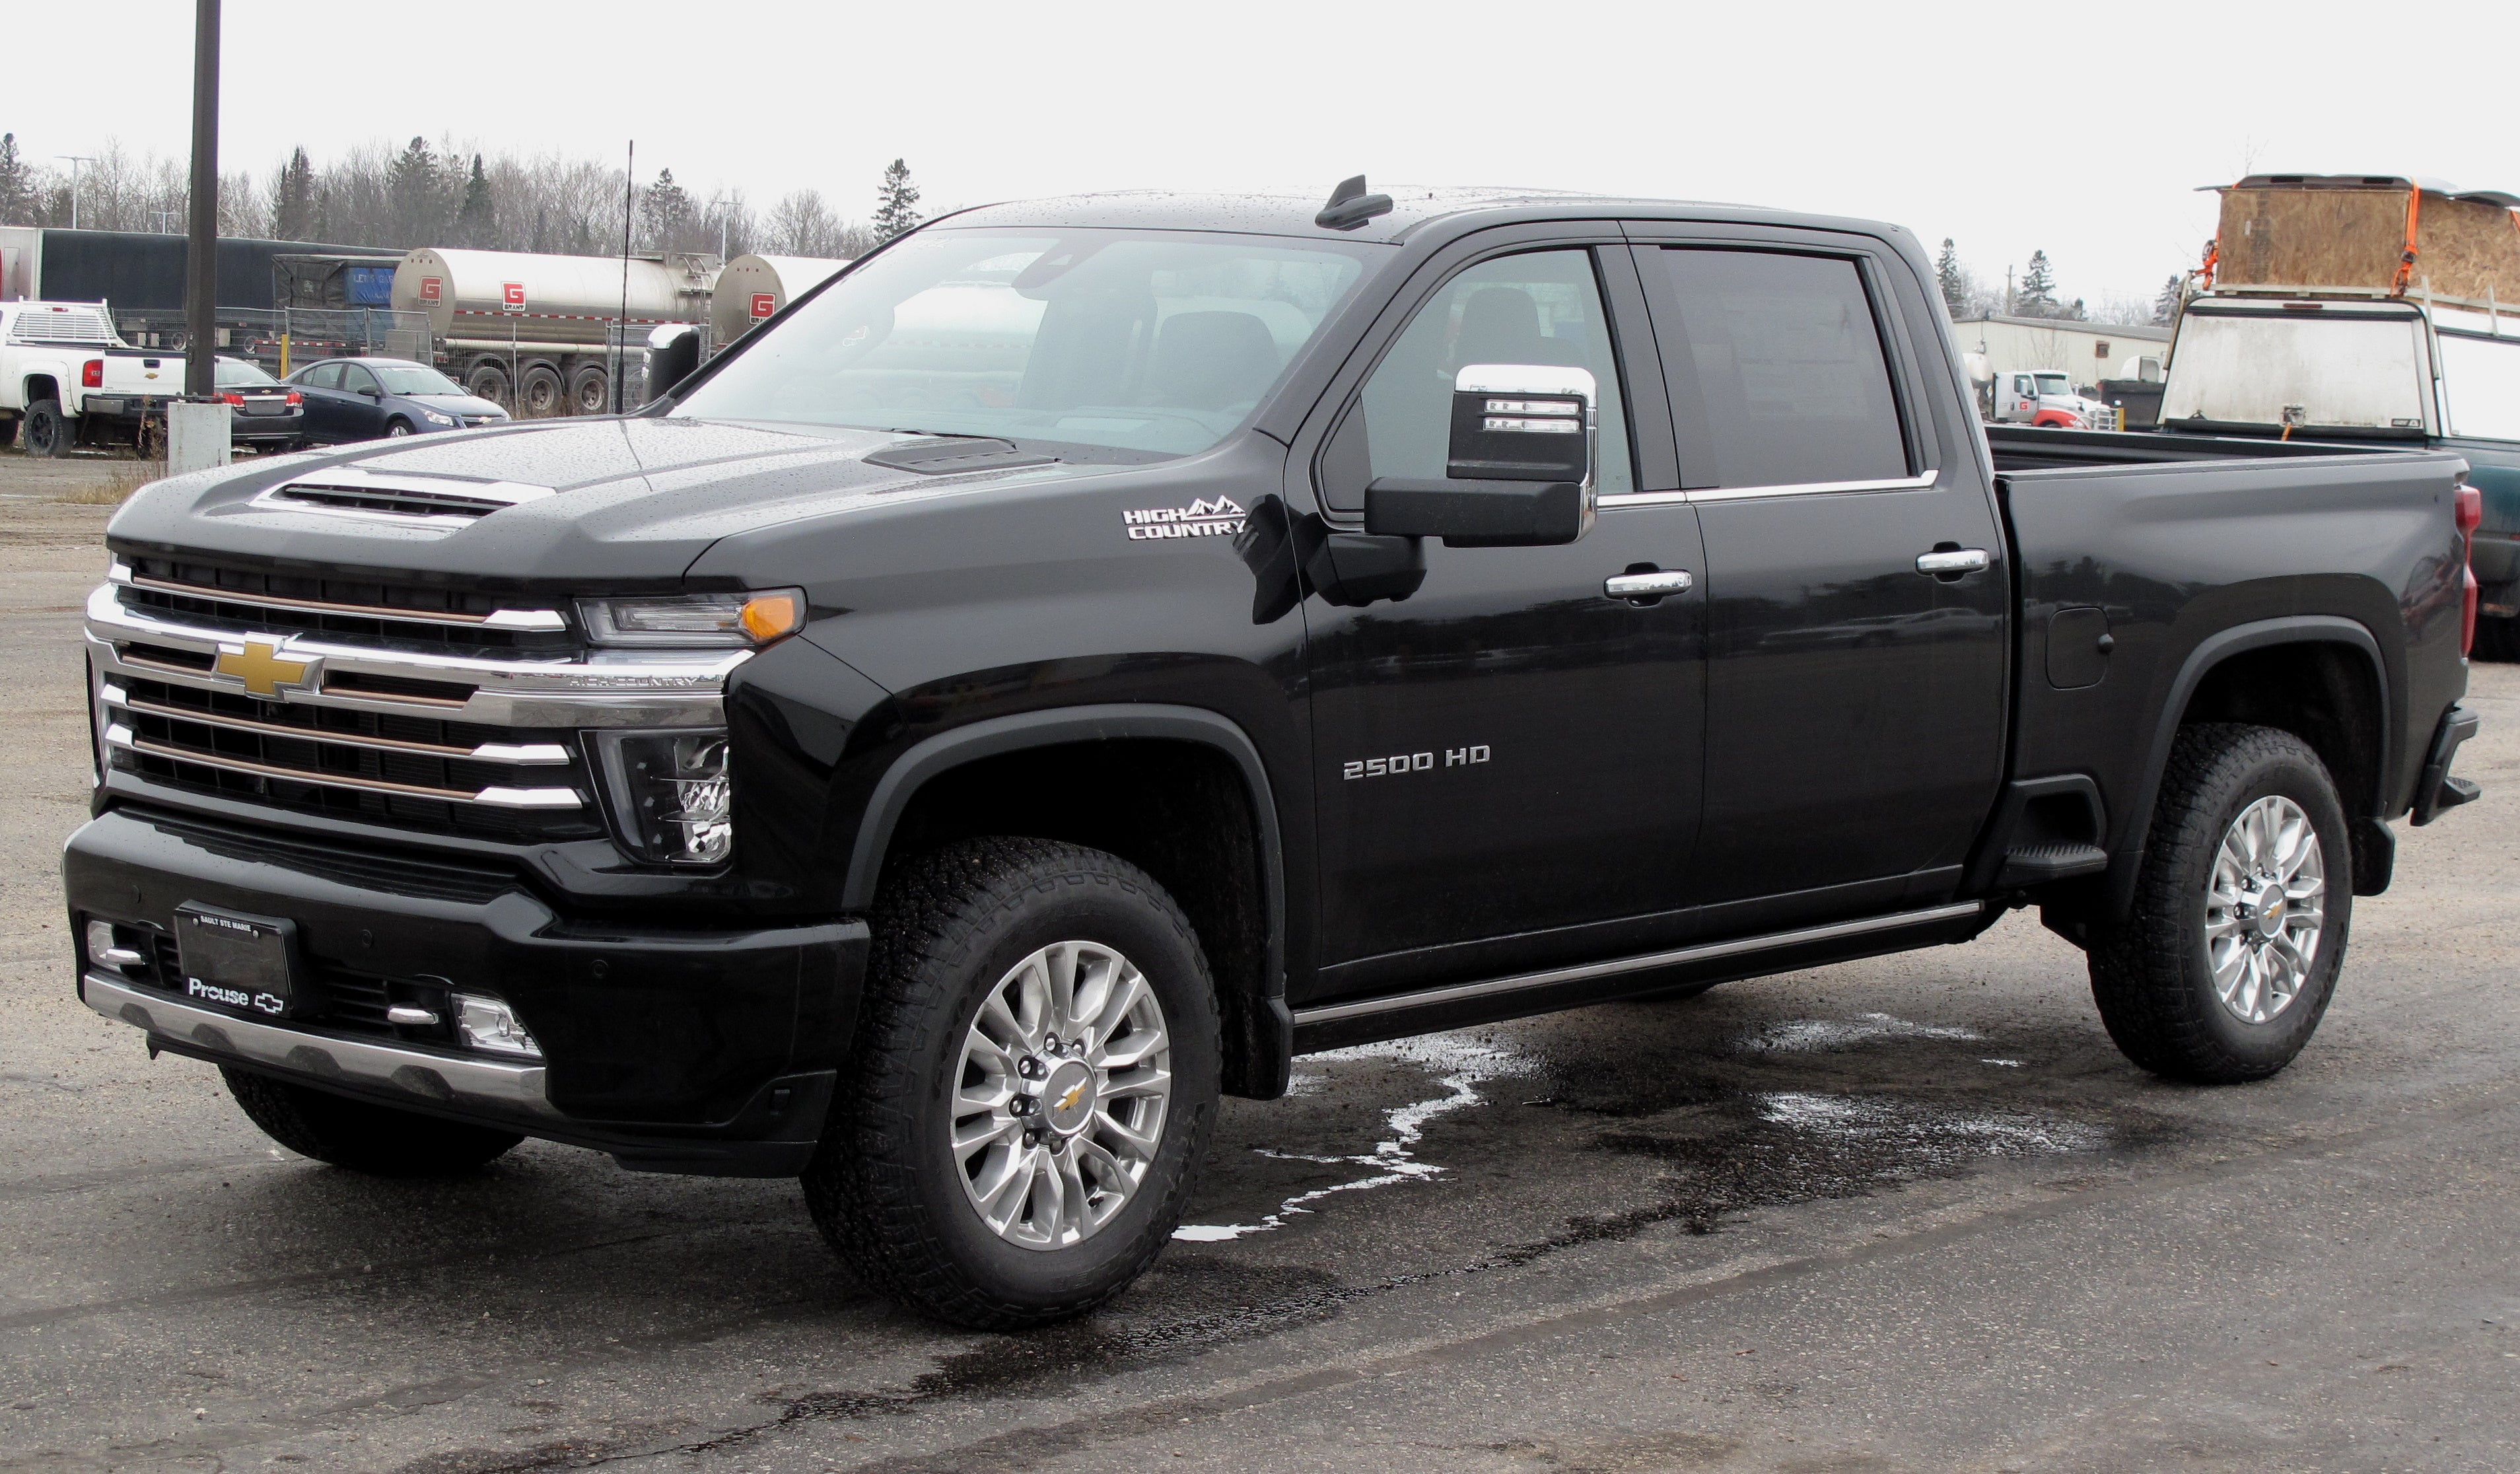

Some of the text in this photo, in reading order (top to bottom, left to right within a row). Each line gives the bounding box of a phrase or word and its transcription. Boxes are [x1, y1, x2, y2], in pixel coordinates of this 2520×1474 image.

[1122, 507, 1187, 525] HIGH
[1127, 520, 1246, 540] COUNTRY
[615, 677, 698, 686] COUNTRY
[1343, 745, 1490, 781] 2500 HD
[200, 915, 252, 932] SAULT STE MARIE
[189, 977, 249, 1006] Prouse
